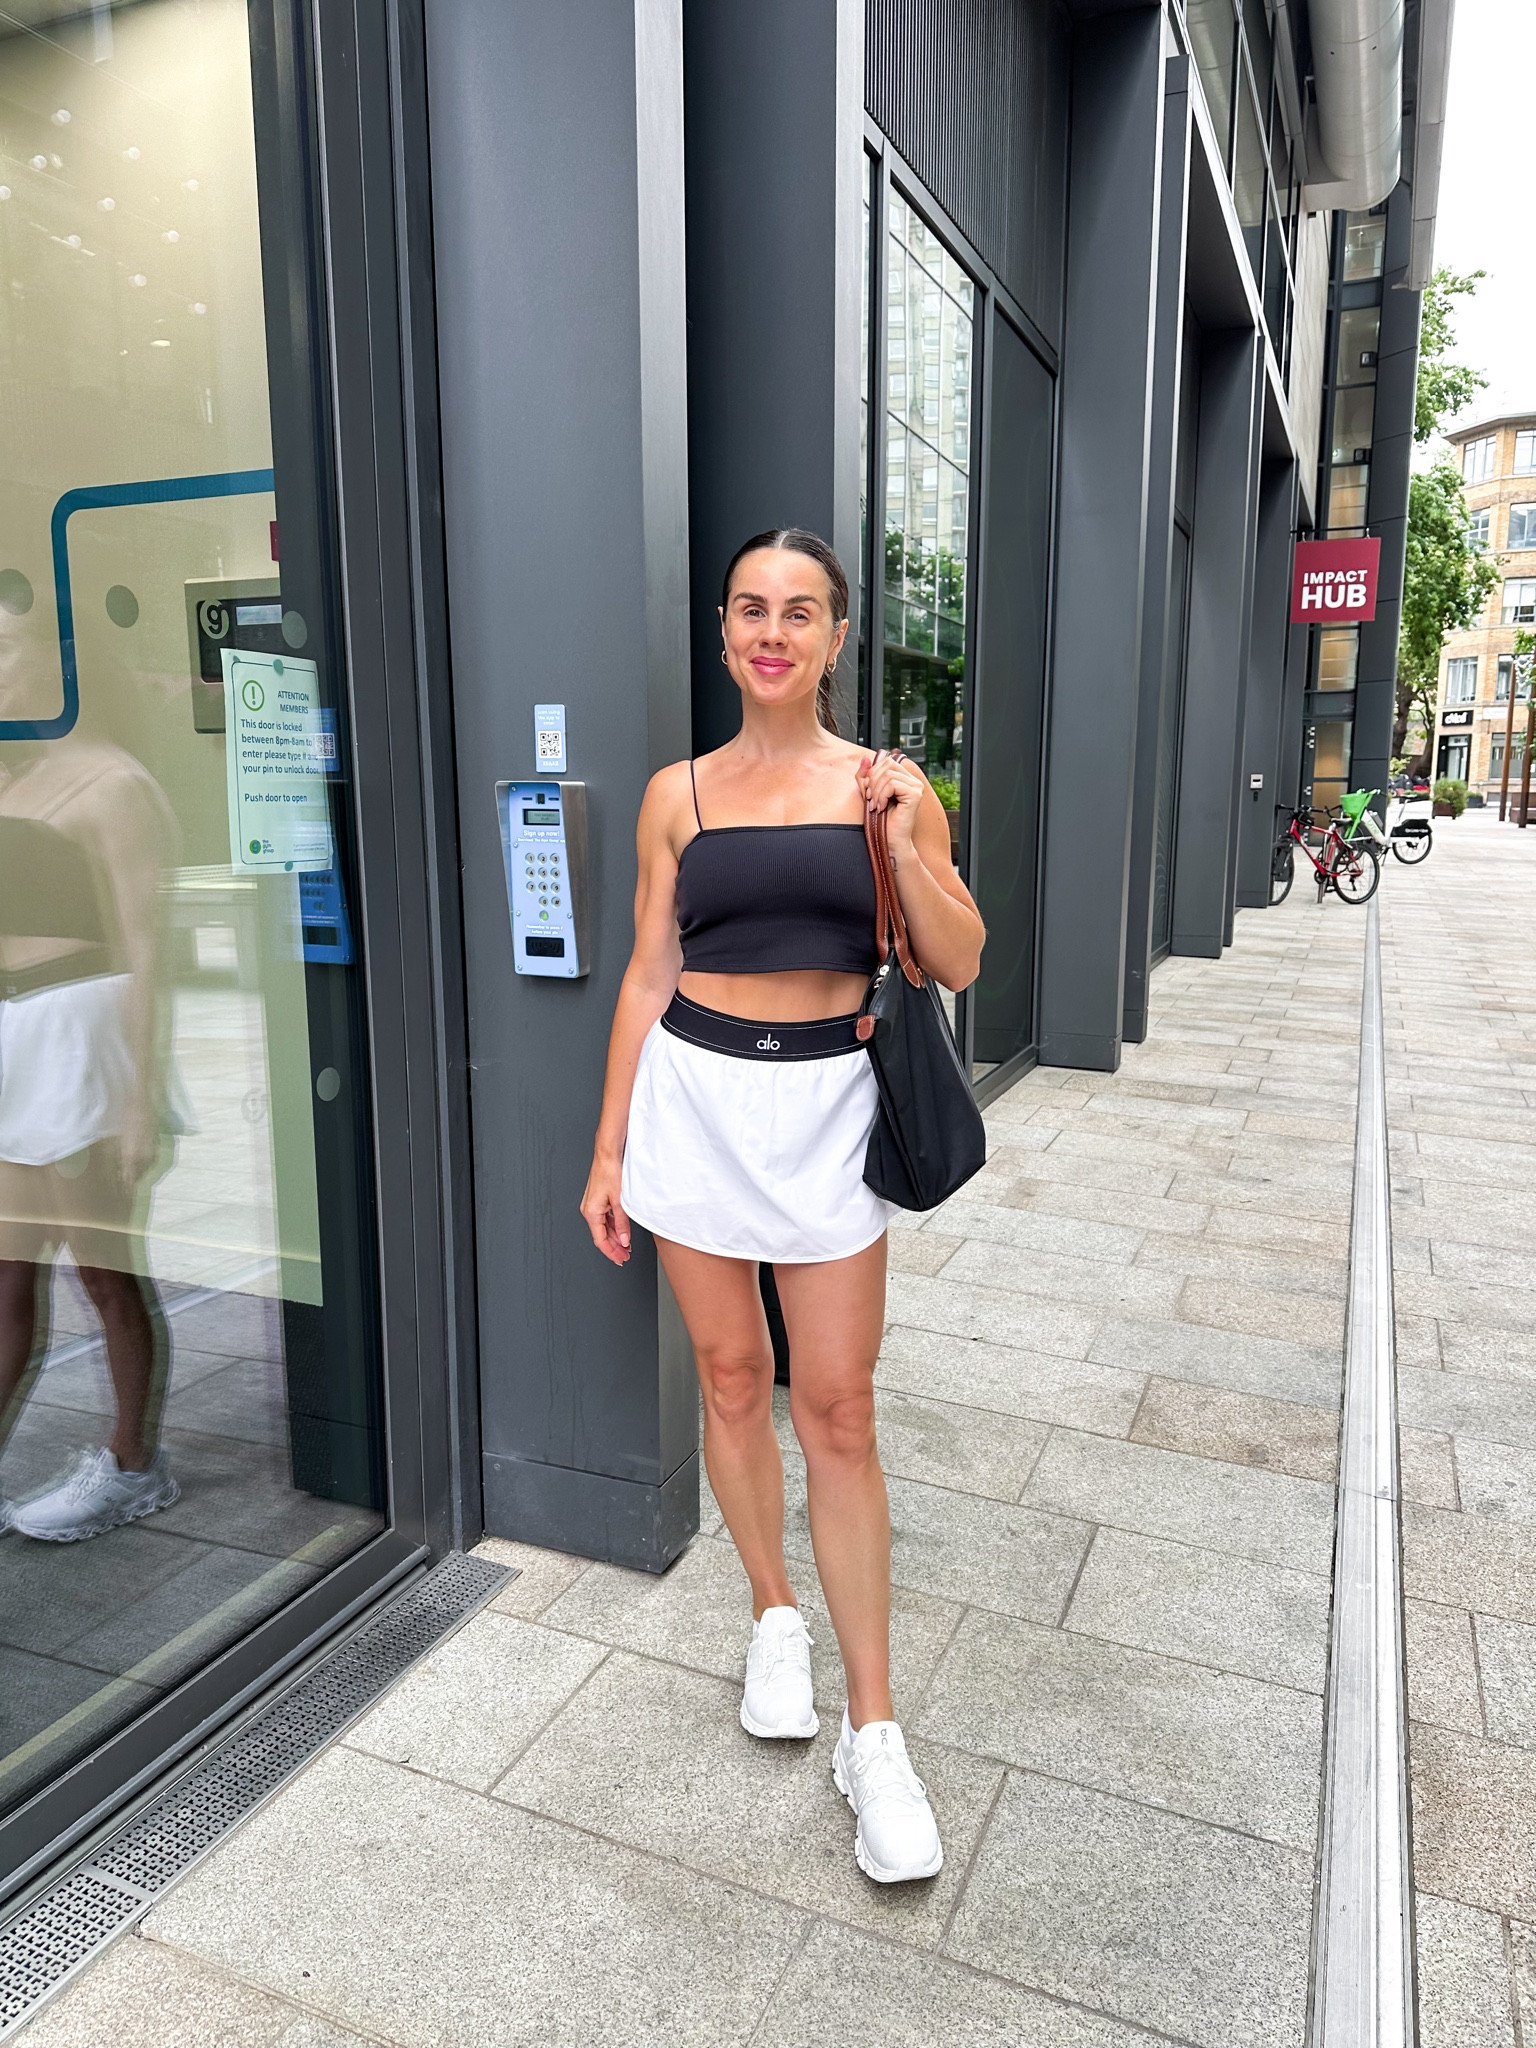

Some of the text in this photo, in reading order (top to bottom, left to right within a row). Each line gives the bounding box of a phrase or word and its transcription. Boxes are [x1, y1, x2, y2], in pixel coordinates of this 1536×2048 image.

[1303, 569, 1368, 585] IMPACT
[1301, 583, 1367, 610] HUB
[277, 690, 310, 702] ATTENTION
[279, 703, 309, 714] MEMBERS
[240, 718, 303, 732] This door is locked
[241, 733, 313, 747] between 8pm-8am to
[242, 750, 263, 759] enter
[264, 750, 287, 760] please
[287, 752, 302, 762] type
[242, 765, 261, 774] your
[262, 764, 274, 775] pin
[275, 765, 283, 773] to
[284, 765, 305, 774] unlock
[244, 793, 308, 804] Push door to open
[523, 830, 537, 838] Sign
[756, 1033, 781, 1051] alo
